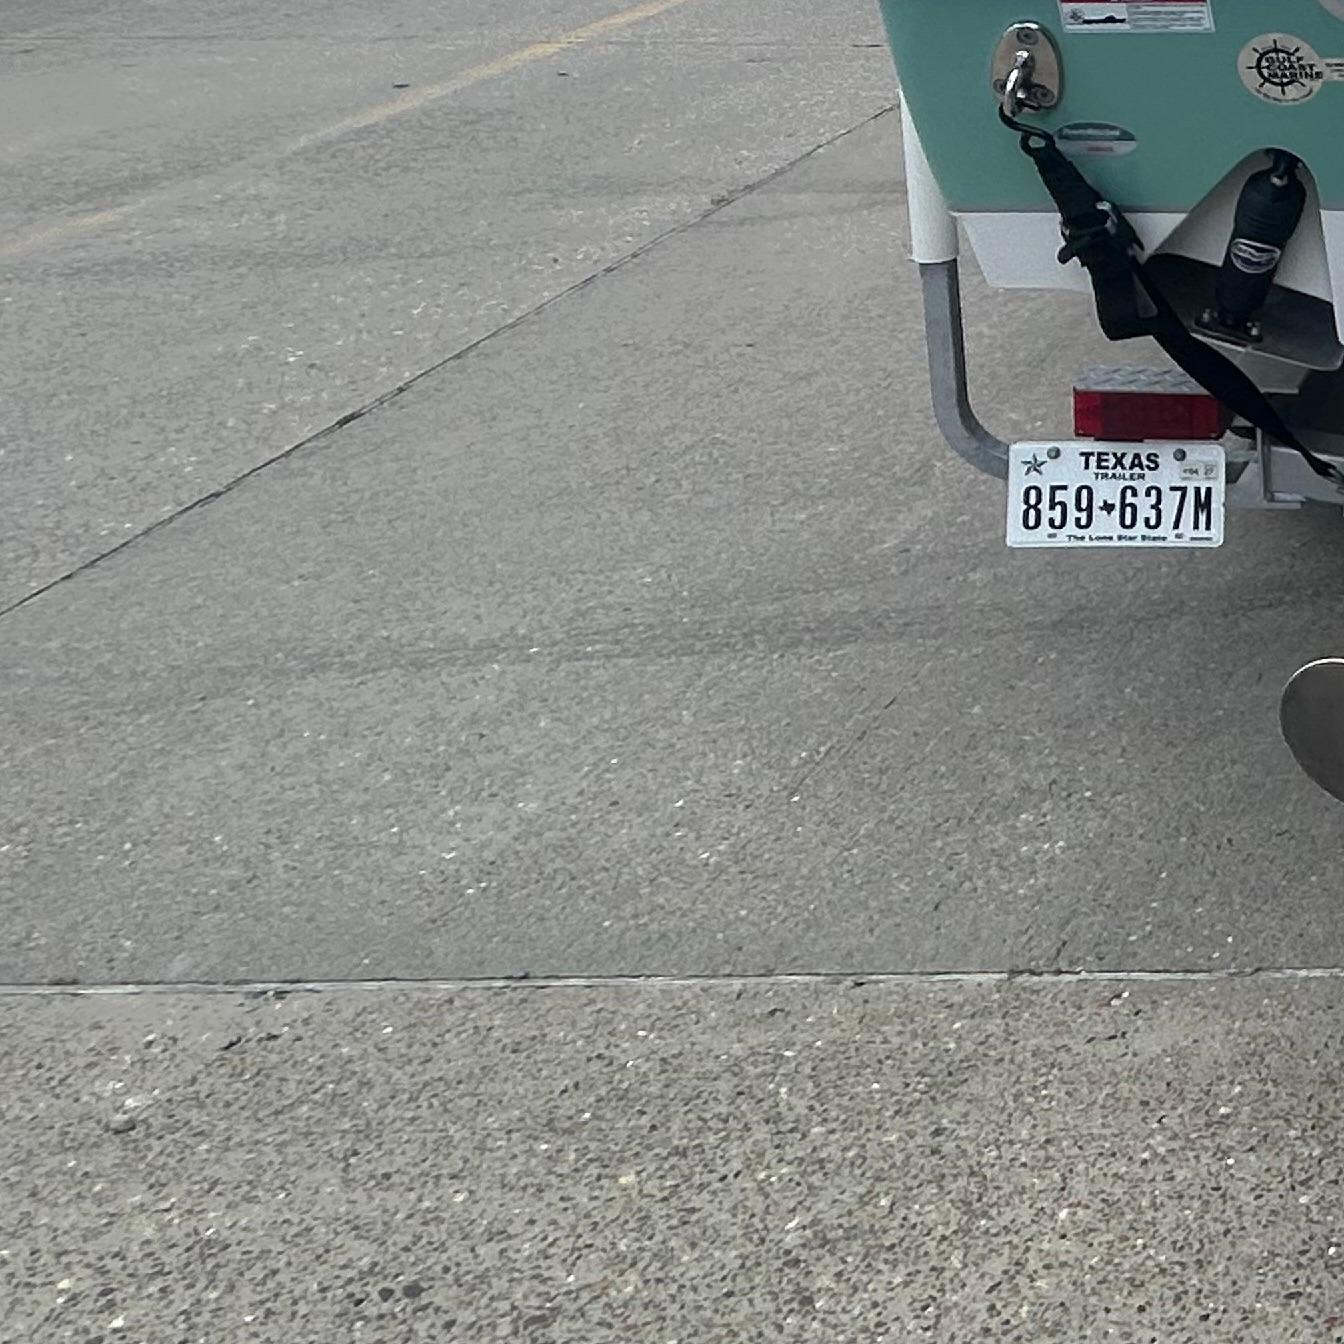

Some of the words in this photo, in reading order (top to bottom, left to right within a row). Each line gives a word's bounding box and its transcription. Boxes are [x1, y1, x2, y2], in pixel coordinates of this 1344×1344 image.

[1079, 451, 1160, 472] TEXAS
[1093, 472, 1146, 482] TRAILER
[1066, 534, 1085, 543] The
[1088, 534, 1114, 543] Lone
[1117, 533, 1138, 543] Star
[1140, 533, 1168, 543] State
